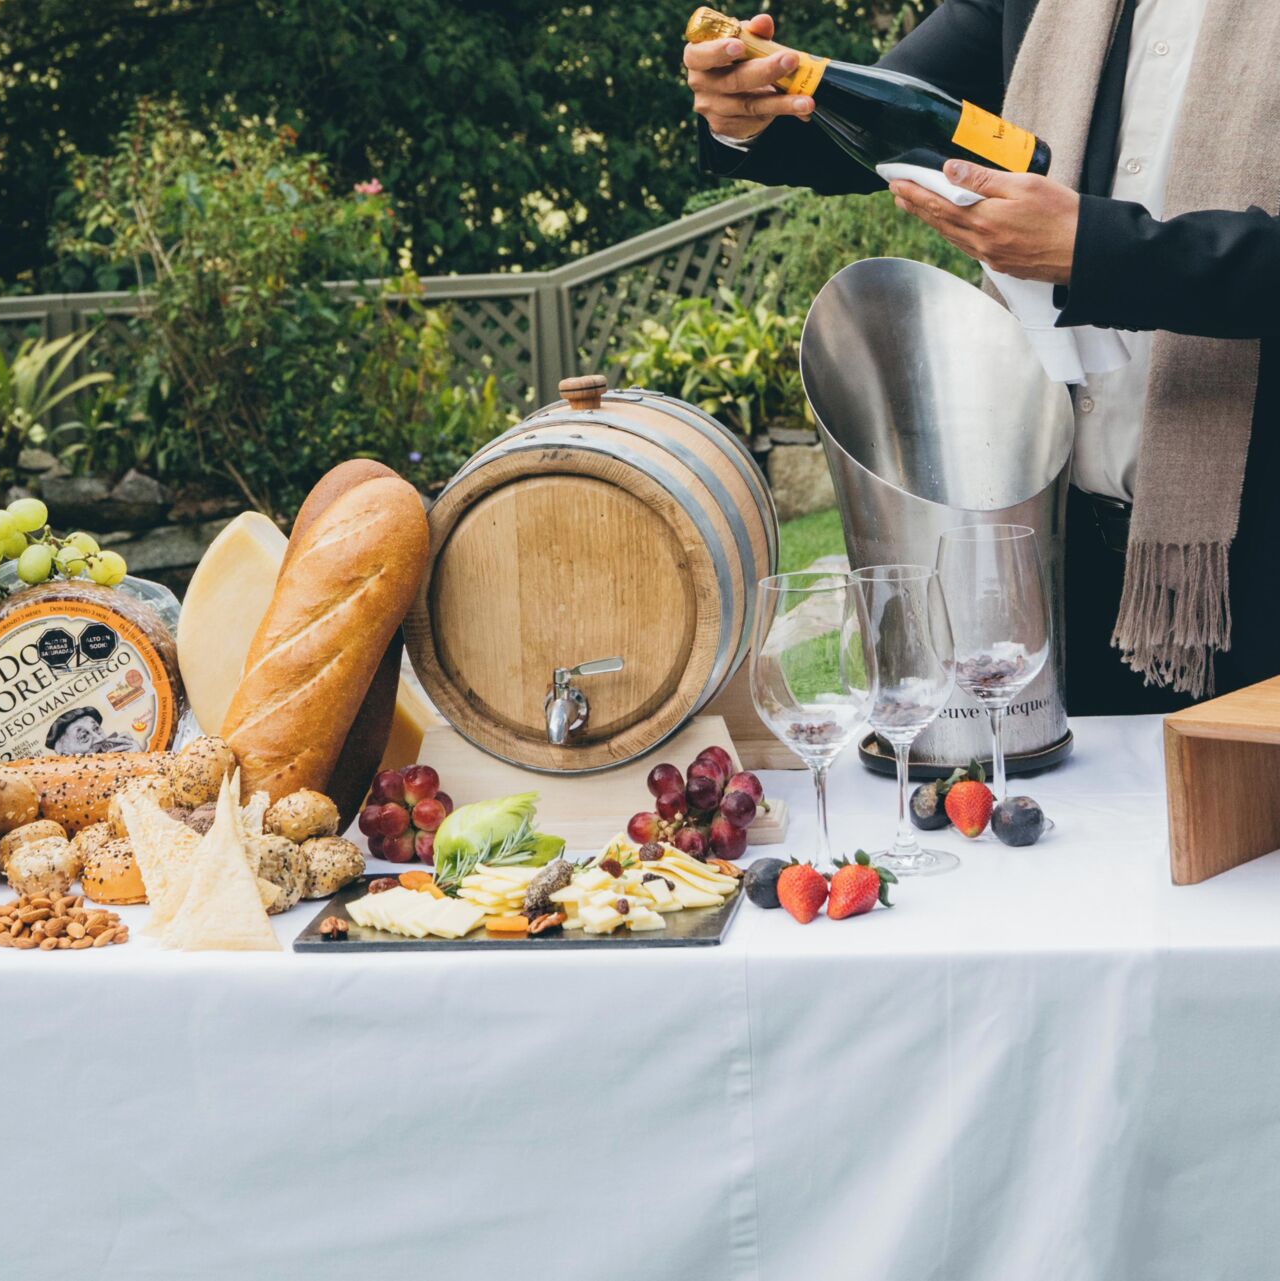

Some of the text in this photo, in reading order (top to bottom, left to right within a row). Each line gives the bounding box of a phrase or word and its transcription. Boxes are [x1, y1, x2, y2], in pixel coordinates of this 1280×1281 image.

[41, 649, 73, 657] SAURADAS
[38, 651, 131, 717] MANCHEGO
[939, 707, 980, 719] euve
